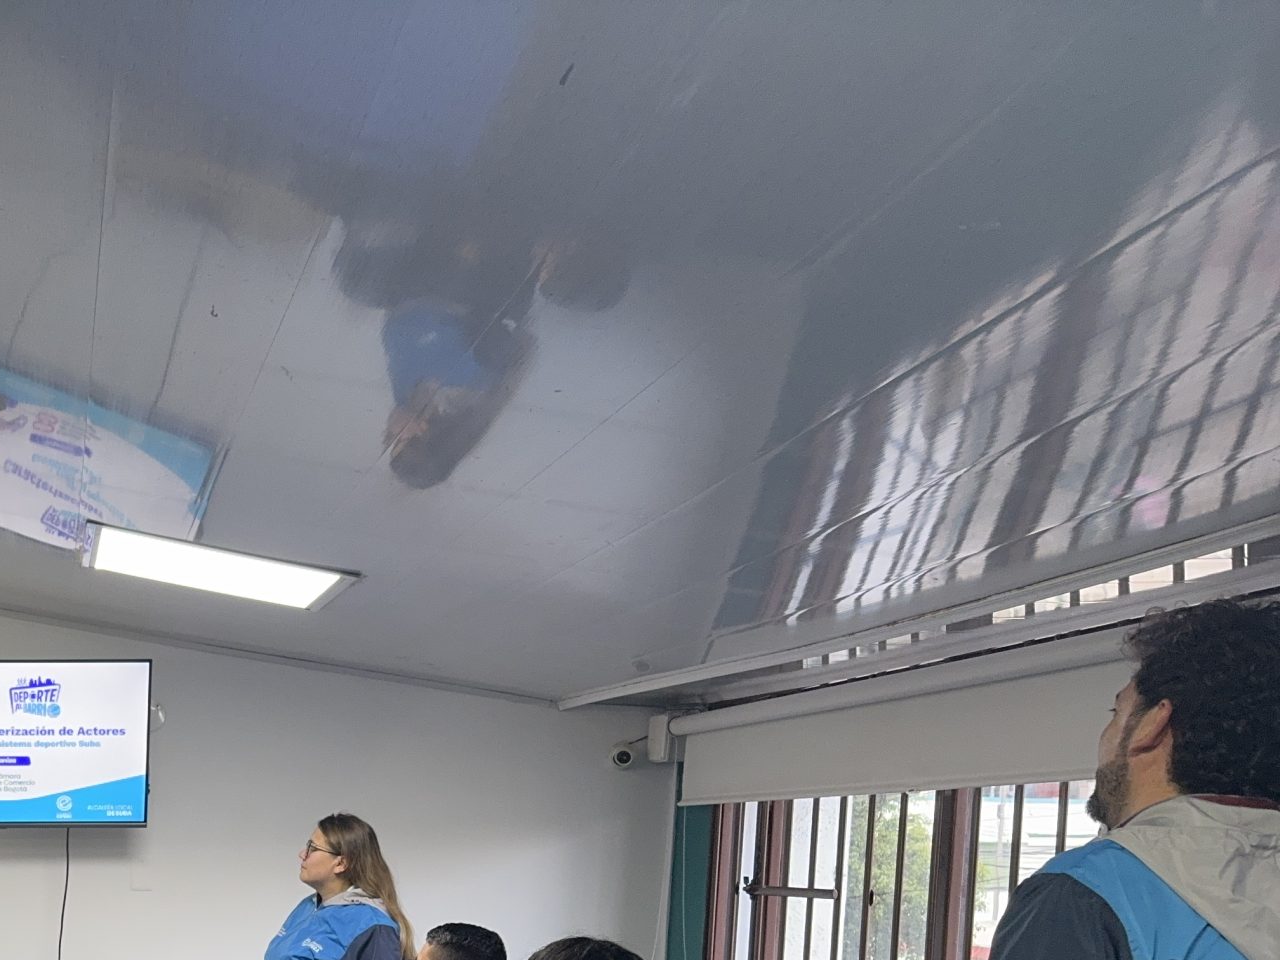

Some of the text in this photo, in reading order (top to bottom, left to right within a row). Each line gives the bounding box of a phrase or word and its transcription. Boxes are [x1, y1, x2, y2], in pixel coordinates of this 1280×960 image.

[13, 688, 57, 703] DEPORTE
[59, 726, 74, 736] de
[77, 726, 126, 736] Actores
[34, 740, 77, 749] deportivo
[79, 740, 101, 748] Suba
